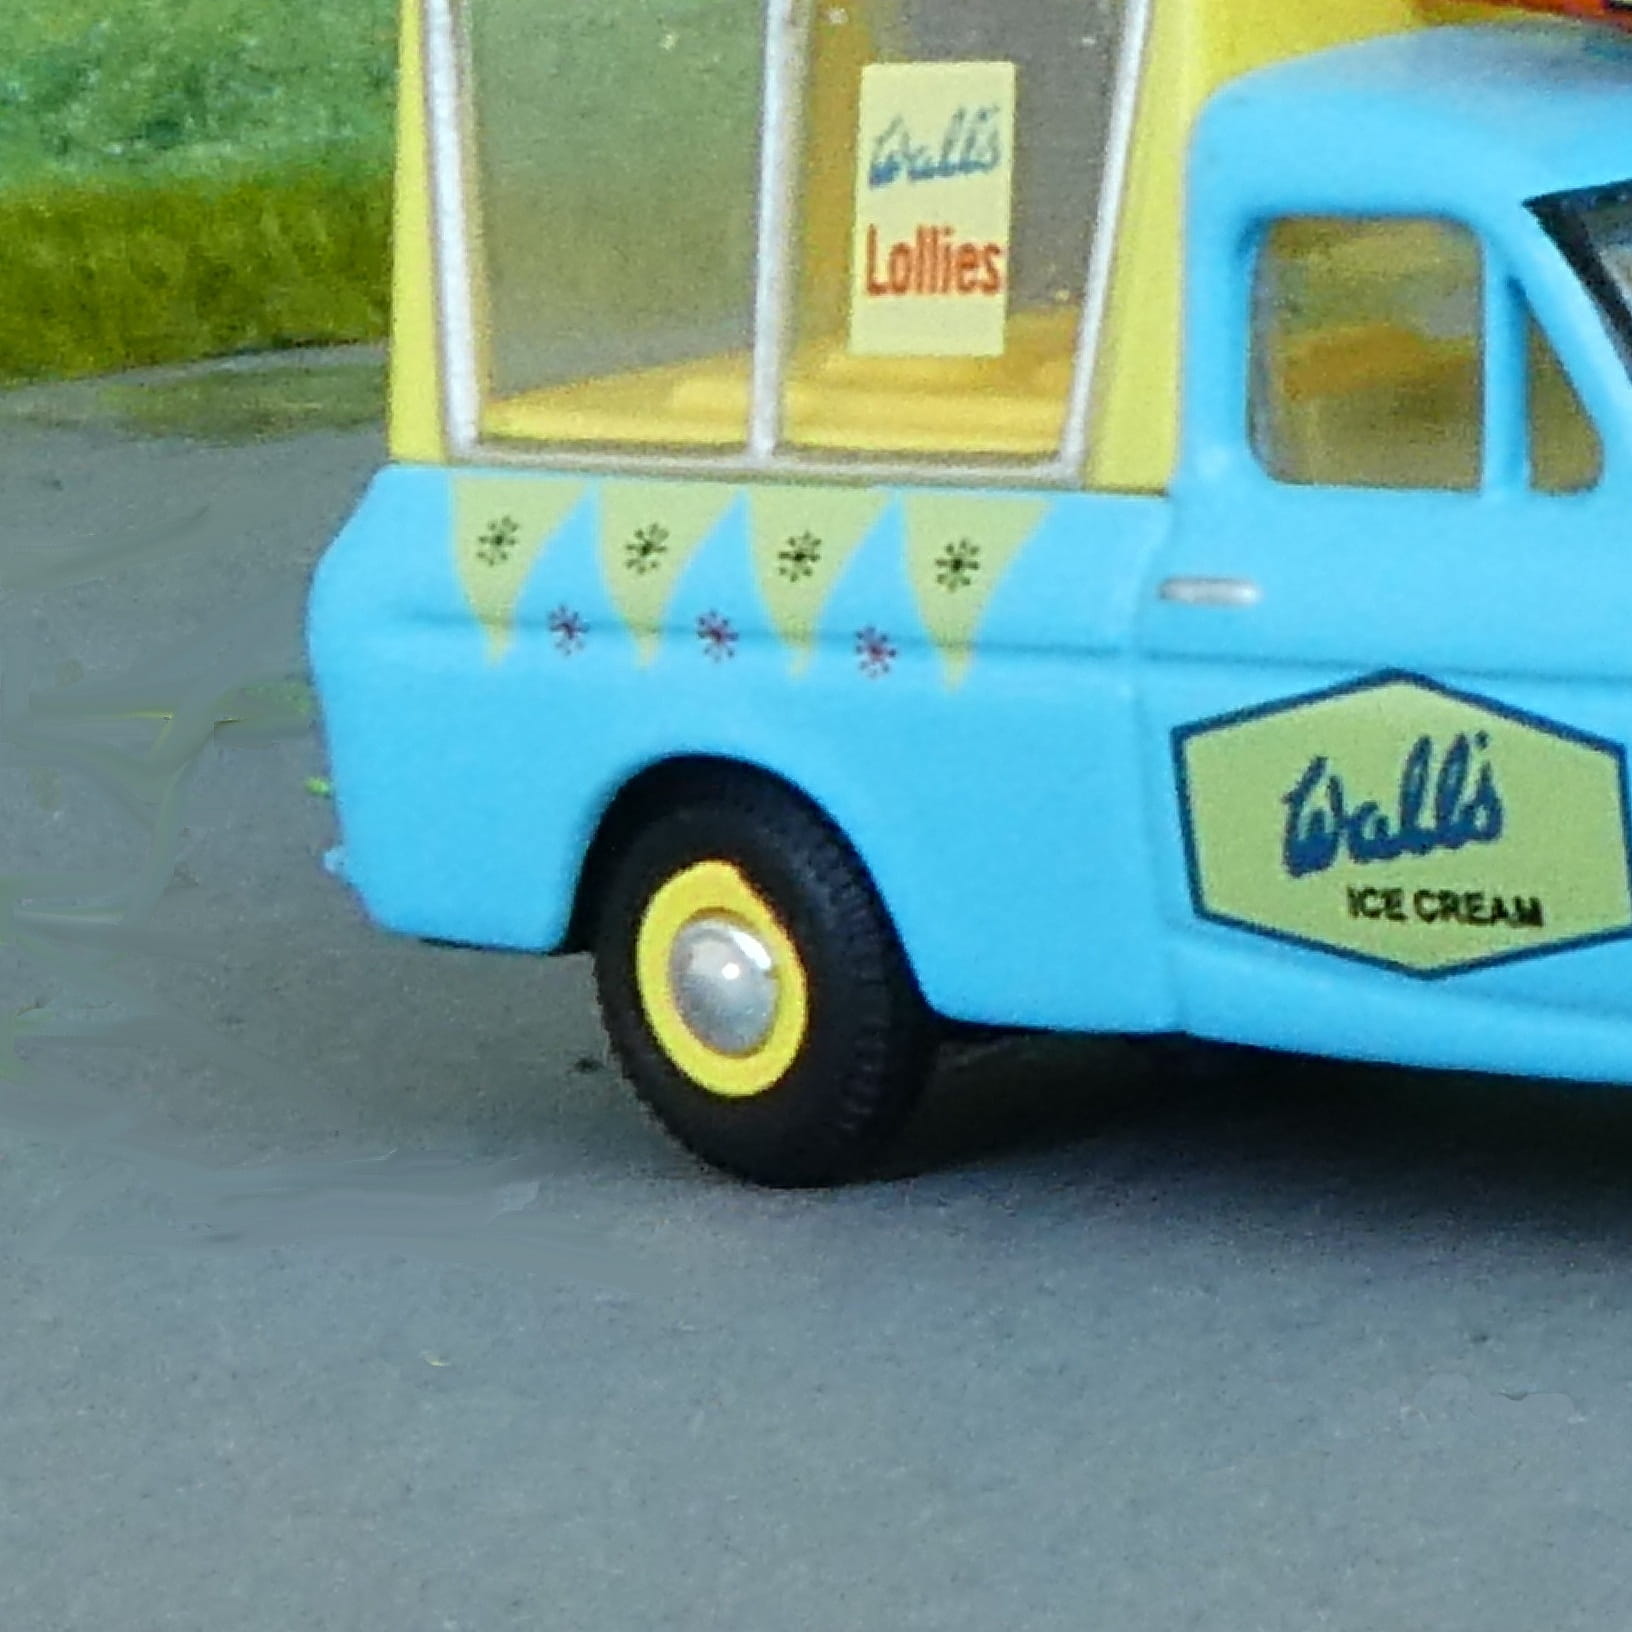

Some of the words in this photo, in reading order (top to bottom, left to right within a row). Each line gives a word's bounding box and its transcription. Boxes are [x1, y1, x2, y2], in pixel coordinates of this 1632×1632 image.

[866, 222, 1003, 298] Lollies
[1280, 730, 1506, 879] Wall's
[1346, 884, 1407, 924] ICE
[1412, 886, 1545, 931] CREAM
